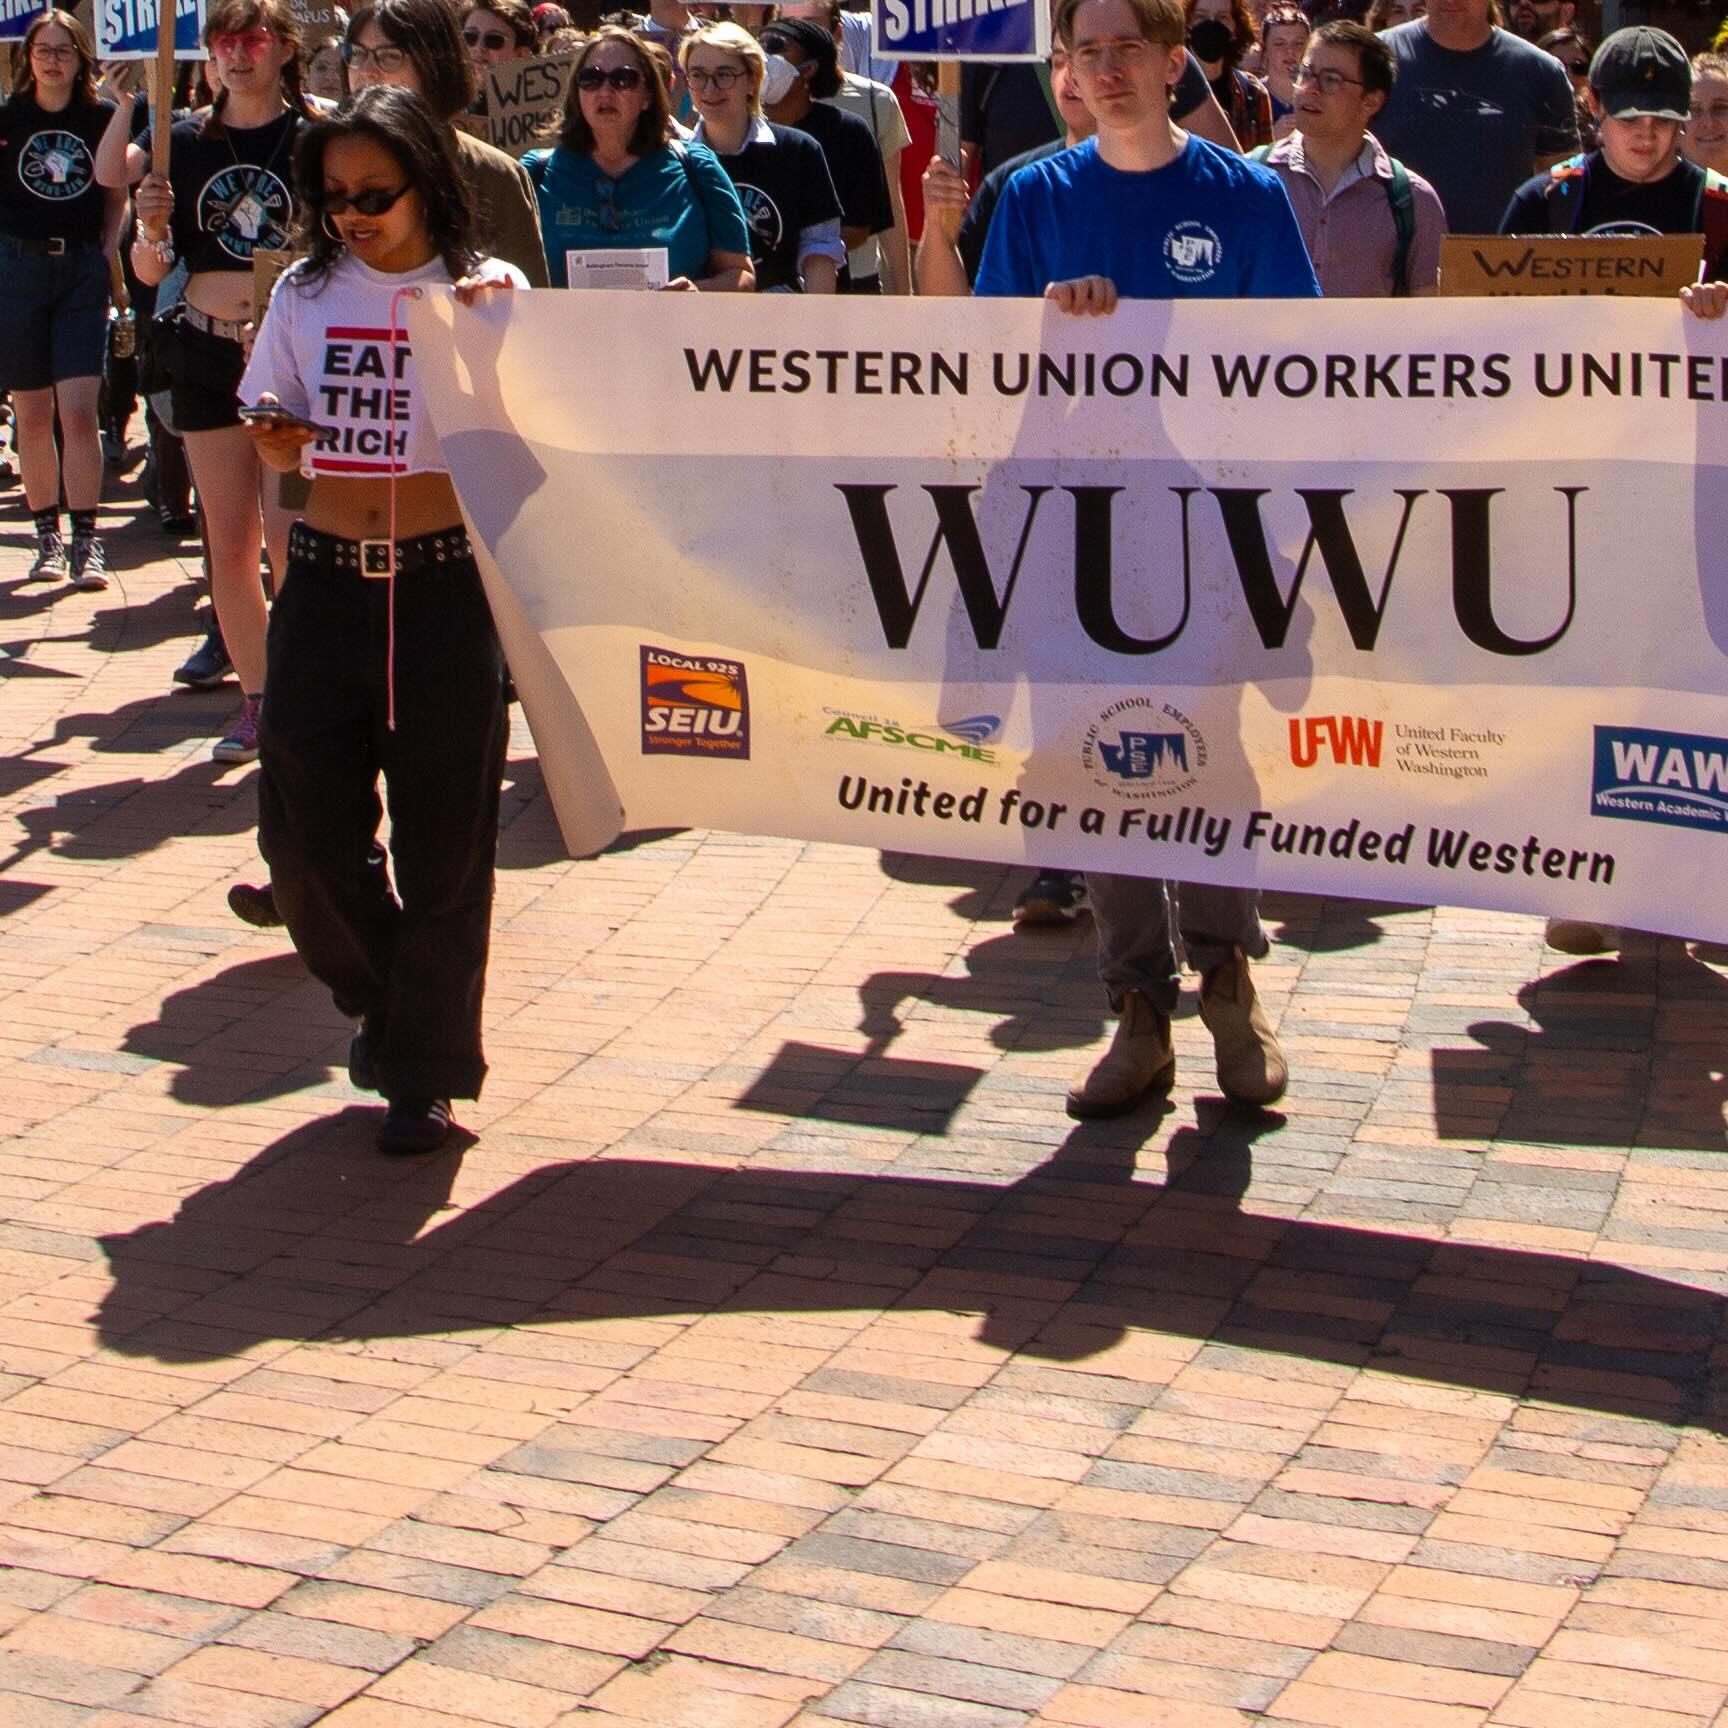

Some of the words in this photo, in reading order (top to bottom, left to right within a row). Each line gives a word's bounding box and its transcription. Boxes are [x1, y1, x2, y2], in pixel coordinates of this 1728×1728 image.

[211, 173, 239, 199] WE
[324, 344, 413, 380] EAT
[683, 347, 969, 396] WESTERN
[992, 352, 1189, 398] UNION
[1210, 352, 1512, 398] WORKERS
[320, 385, 410, 421] THE
[315, 424, 408, 457] RICH
[832, 483, 1590, 656] WUWU
[647, 652, 705, 671] LOCAL
[707, 662, 738, 675] 925
[825, 717, 997, 764] AFSCME
[1082, 724, 1100, 769] PUBLIC
[1100, 697, 1154, 722] SCHOOL
[1394, 724, 1445, 741] United
[1450, 727, 1506, 746] Faculty
[1396, 743, 1412, 756] of
[1416, 744, 1479, 760] Western
[1396, 759, 1488, 780] Washington
[1595, 792, 1654, 812] Western
[1657, 799, 1721, 821] Academic
[838, 776, 989, 823] United
[999, 788, 1067, 831] for
[1079, 807, 1105, 836] a
[1118, 807, 1232, 857] Fully
[1243, 811, 1416, 864] Funded
[1427, 827, 1616, 885] Western
